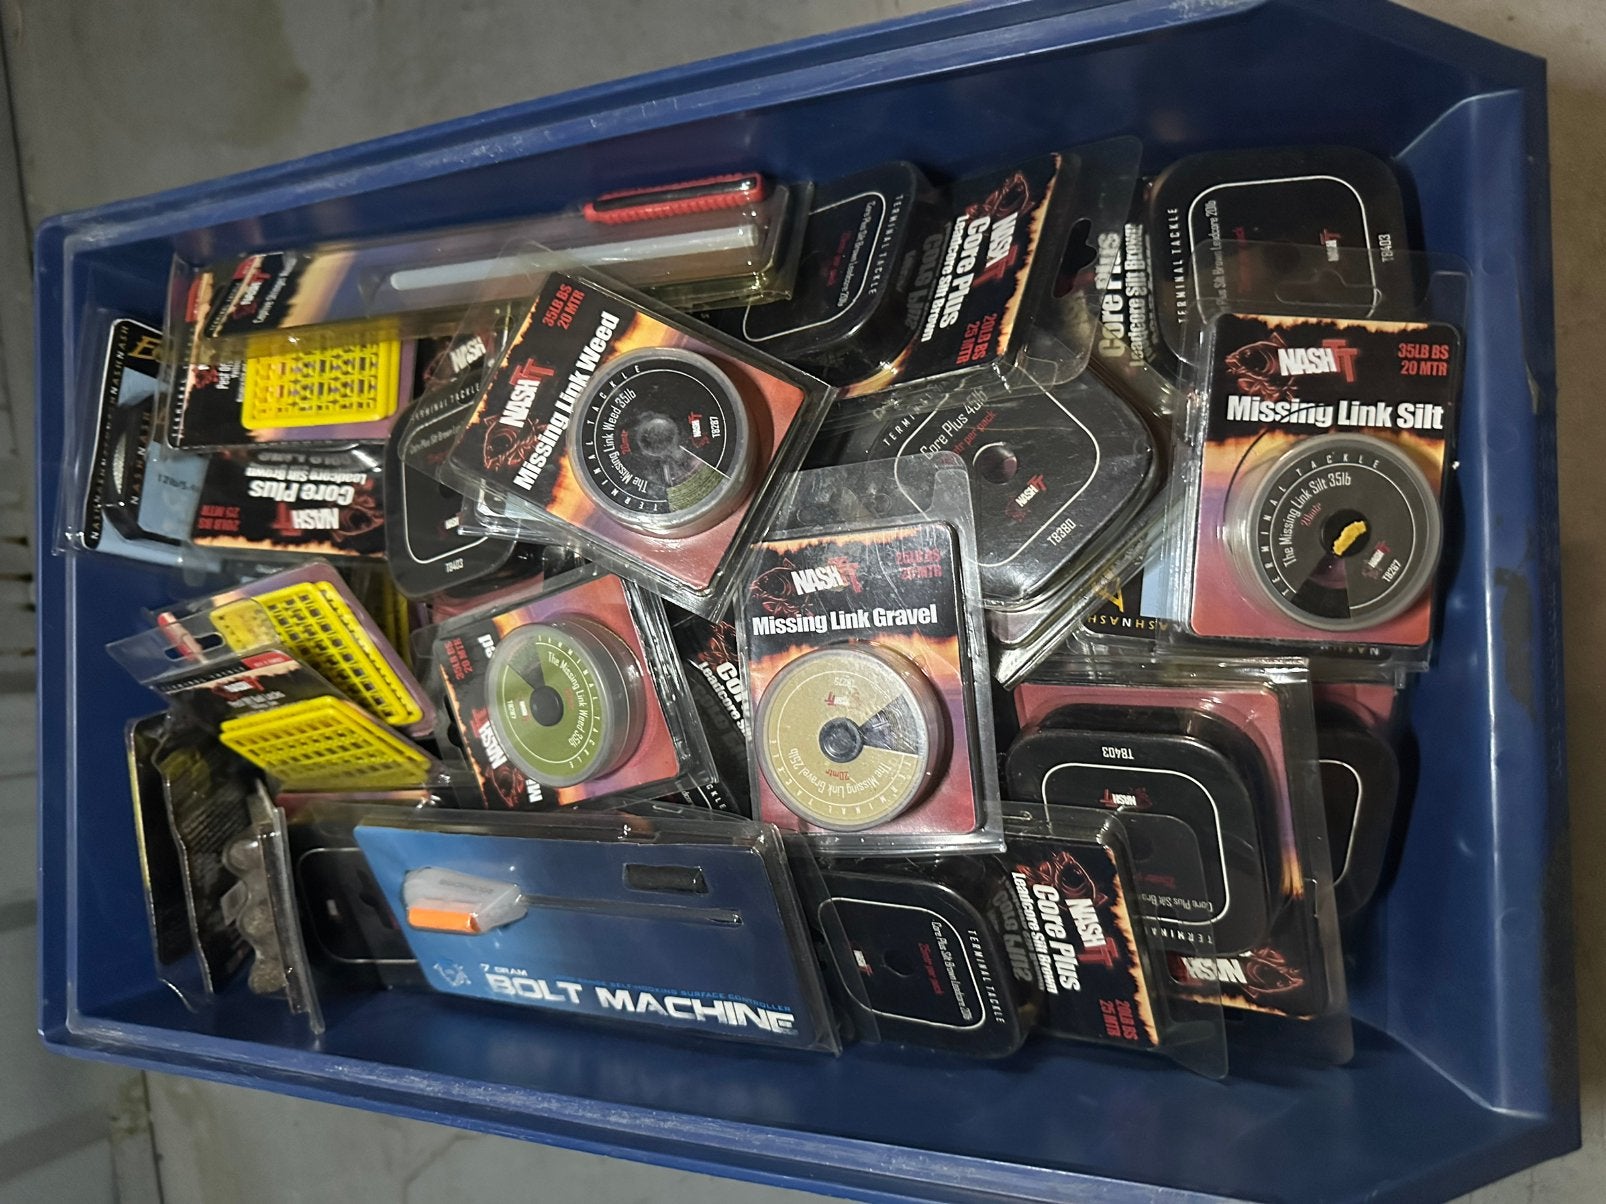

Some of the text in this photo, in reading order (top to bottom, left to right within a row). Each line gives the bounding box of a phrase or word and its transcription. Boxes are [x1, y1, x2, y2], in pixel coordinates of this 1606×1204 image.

[942, 214, 970, 275] Leadcore
[986, 212, 1018, 268] NASH
[1208, 217, 1221, 251] Leadcore
[1379, 234, 1394, 263] T8403
[868, 252, 887, 295] TACKLE
[940, 216, 991, 328] Core Plus
[1167, 207, 1187, 324] TERMINAL TACKLE
[935, 274, 952, 299] Silt
[1124, 224, 1148, 367] Leadcore Silt Brown
[542, 284, 572, 327] 35LB BS
[557, 290, 585, 330] 20 MTR
[921, 298, 945, 342] Brown
[956, 321, 980, 365] 25 MTR
[972, 313, 998, 360] 20LB BS
[1099, 294, 1125, 357] Core
[449, 336, 487, 373] NASH
[1278, 348, 1337, 376] NASH
[1398, 343, 1449, 359] 35LB BS
[1401, 360, 1447, 376] 20 MTR
[499, 380, 540, 428] NASH
[513, 310, 620, 491] Missing Link Weed
[1226, 395, 1444, 430] Missing Link Silt
[585, 365, 658, 512] TERMINAL TACKLE
[601, 388, 648, 494] The Missing Link Weed 35lb
[919, 434, 949, 460] Core
[941, 413, 968, 437] Plus
[964, 409, 997, 447] per pack
[245, 467, 367, 485] Leadcore Silt Brown
[248, 480, 355, 506] Core Plus
[1015, 484, 1039, 507] NASH
[291, 507, 340, 529] NASH
[1047, 518, 1076, 546] T8380
[1260, 453, 1380, 597] TERMINAL TACKLE
[1279, 471, 1352, 568] The Missing Link Silt 35lb
[791, 565, 845, 595] NASH
[752, 604, 937, 636] Missing Link Gravel
[538, 635, 598, 700] TERMINAL
[548, 652, 561, 667] The
[560, 659, 580, 691] Missing
[576, 690, 586, 708] Link
[698, 661, 741, 721] Leadcore
[568, 731, 584, 748] 35lb
[576, 709, 589, 733] Weed
[478, 721, 508, 770] NASH
[1101, 746, 1134, 760] T8403
[789, 747, 892, 799] The Missing Link Gravel 25lb
[706, 783, 728, 810] CKLE
[1112, 793, 1137, 806] NASH
[1011, 872, 1040, 931] Leadcore
[1158, 896, 1213, 912] Core Plus Silt
[931, 921, 942, 939] Core
[1032, 884, 1081, 992] Core Plus
[1065, 899, 1107, 947] NASH
[937, 938, 948, 952] Plus
[1031, 931, 1048, 954] Silt
[480, 963, 529, 977] 7 GRAM
[945, 961, 957, 981] Brown
[968, 930, 1006, 1024] TERMINAL TACKLE
[1037, 953, 1059, 995] Brown
[1181, 957, 1248, 984] NASH
[485, 973, 799, 1035] BOLT MACHINE
[681, 990, 727, 999] SURFACE
[728, 993, 791, 1012] CONTROLLER
[950, 980, 966, 1007] Leadcore
[1100, 1000, 1121, 1038] 25 MTR
[1115, 999, 1138, 1041] 20LB BS
